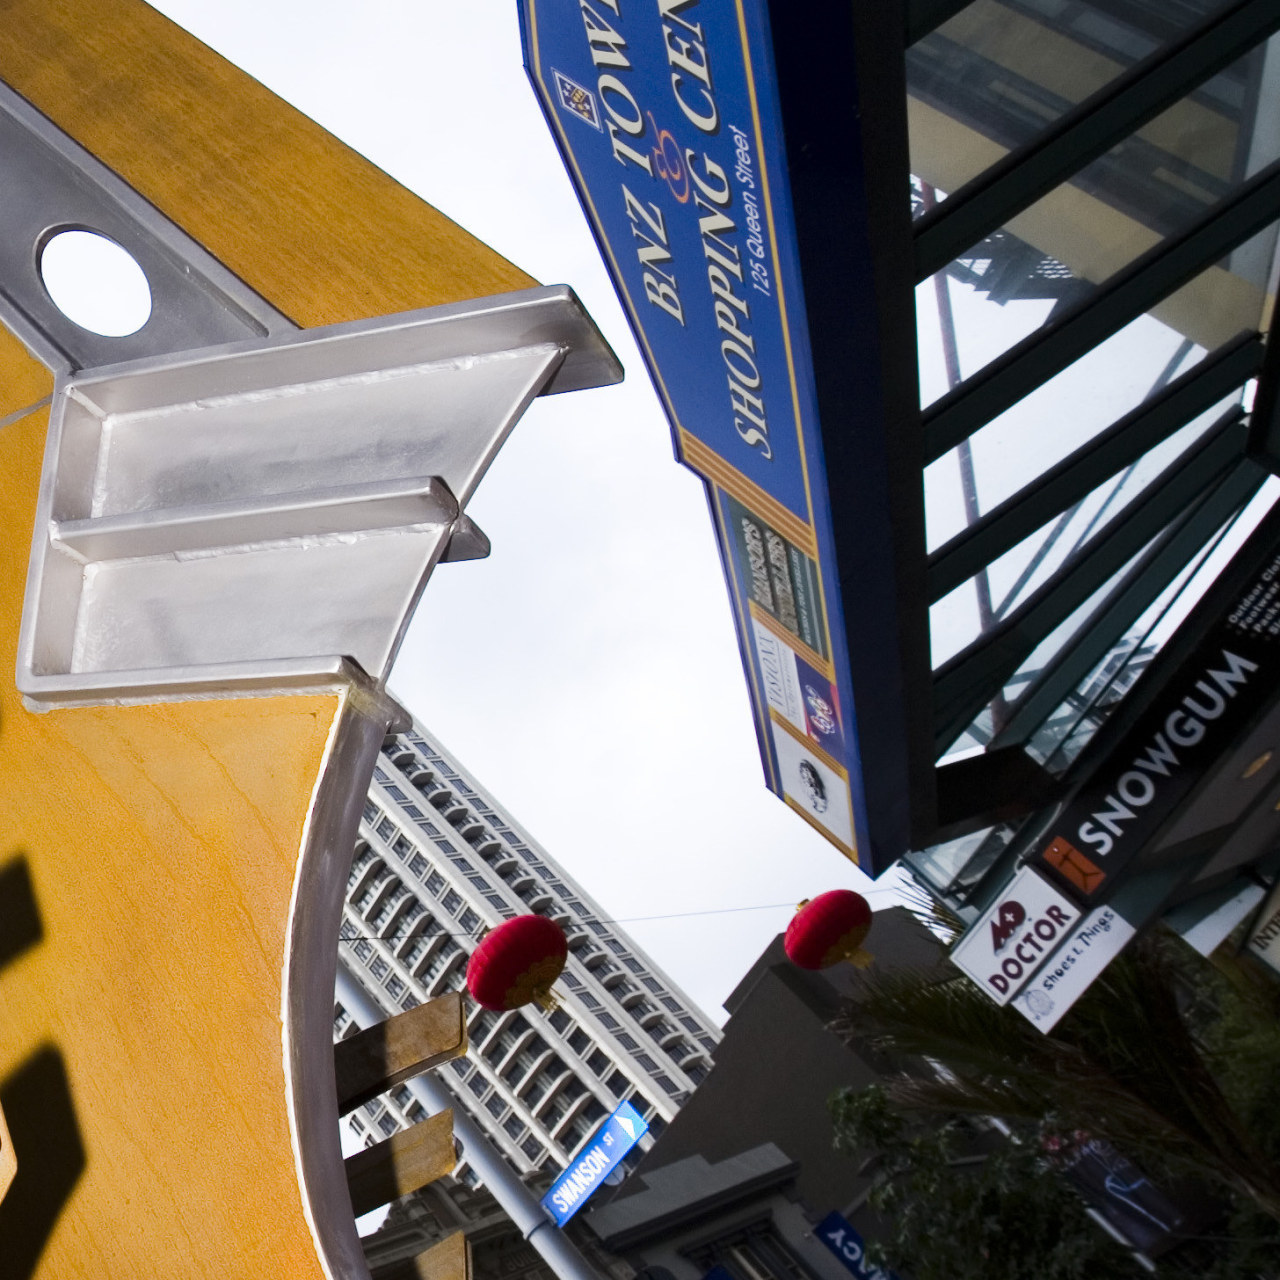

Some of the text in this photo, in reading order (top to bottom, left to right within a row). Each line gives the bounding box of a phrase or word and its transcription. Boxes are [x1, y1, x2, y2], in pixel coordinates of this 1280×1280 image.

[647, 109, 690, 204] &
[622, 183, 685, 327] BNZ
[727, 124, 771, 297] 125 Queen Street
[685, 148, 772, 460] SHOPPING
[1228, 583, 1264, 624] Outdoor
[1238, 581, 1280, 630] Footwear
[1078, 649, 1260, 856] SNOWGUM
[988, 904, 1072, 996] DOCTOR
[1043, 957, 1076, 991] Shoes
[1075, 910, 1115, 947] Things
[552, 1131, 615, 1213] SWANSON ST
